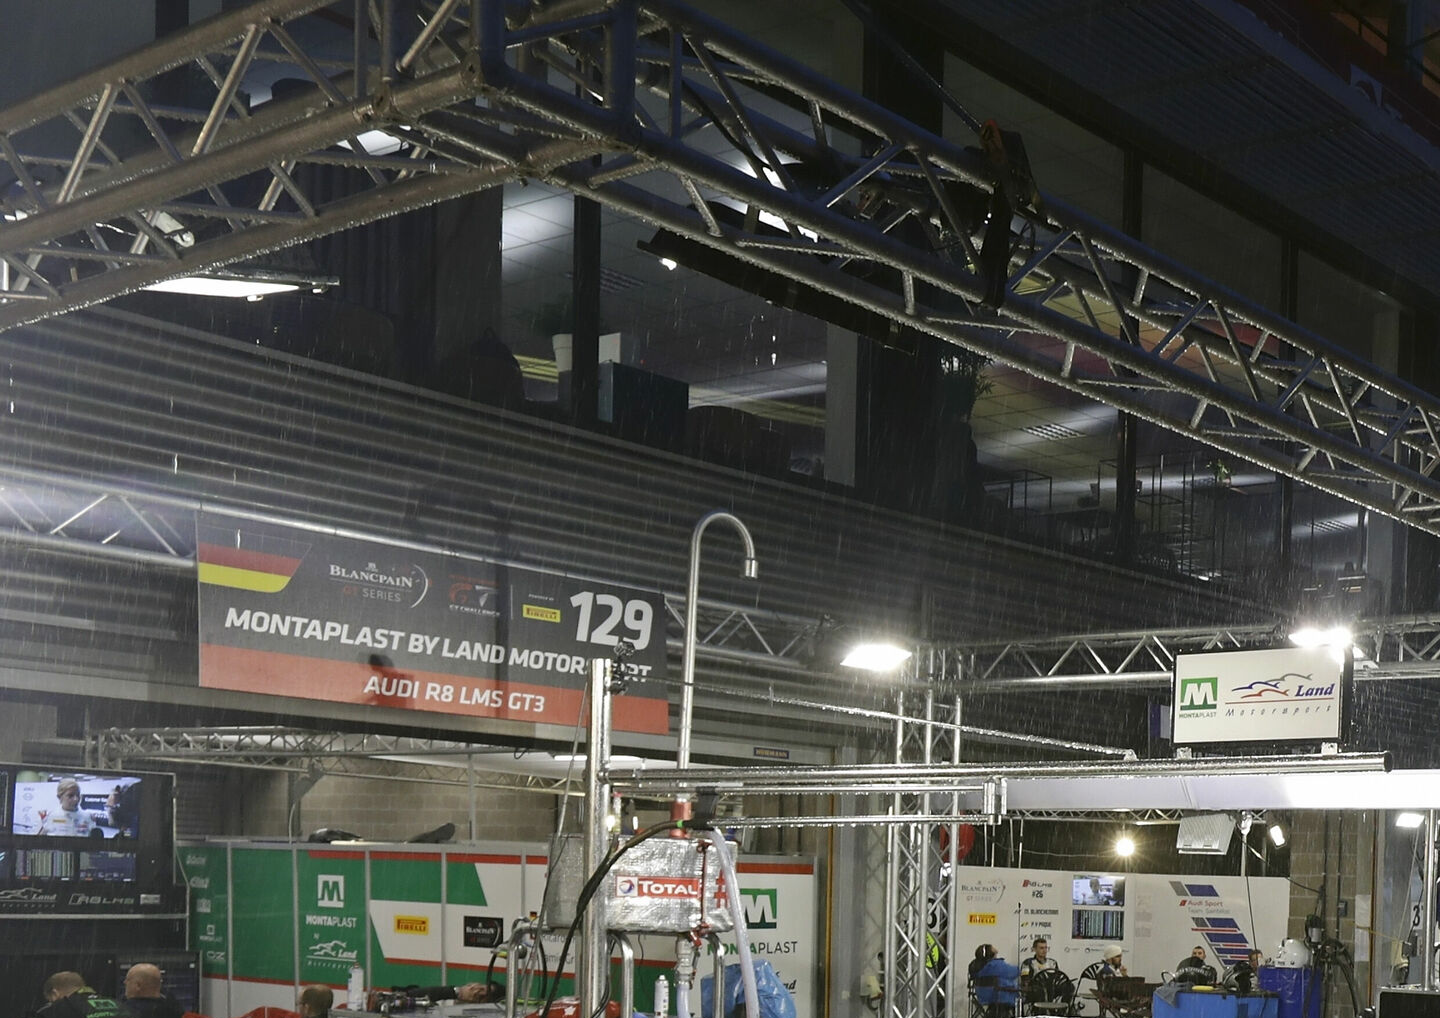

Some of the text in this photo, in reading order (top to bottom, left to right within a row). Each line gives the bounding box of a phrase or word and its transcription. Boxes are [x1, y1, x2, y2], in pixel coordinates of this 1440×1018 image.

[329, 564, 412, 588] BLANCPAIN
[362, 589, 401, 602] SERIES
[570, 591, 653, 650] 129
[224, 608, 405, 650] MONTAPLAST
[408, 633, 441, 656] BY
[442, 638, 506, 664] LAND
[363, 676, 545, 712] AUDI R8 LMS GT3
[1295, 683, 1335, 697] Land
[638, 880, 699, 895] TOTAL
[306, 915, 357, 928] MONTAPLAST
[338, 950, 358, 959] Land
